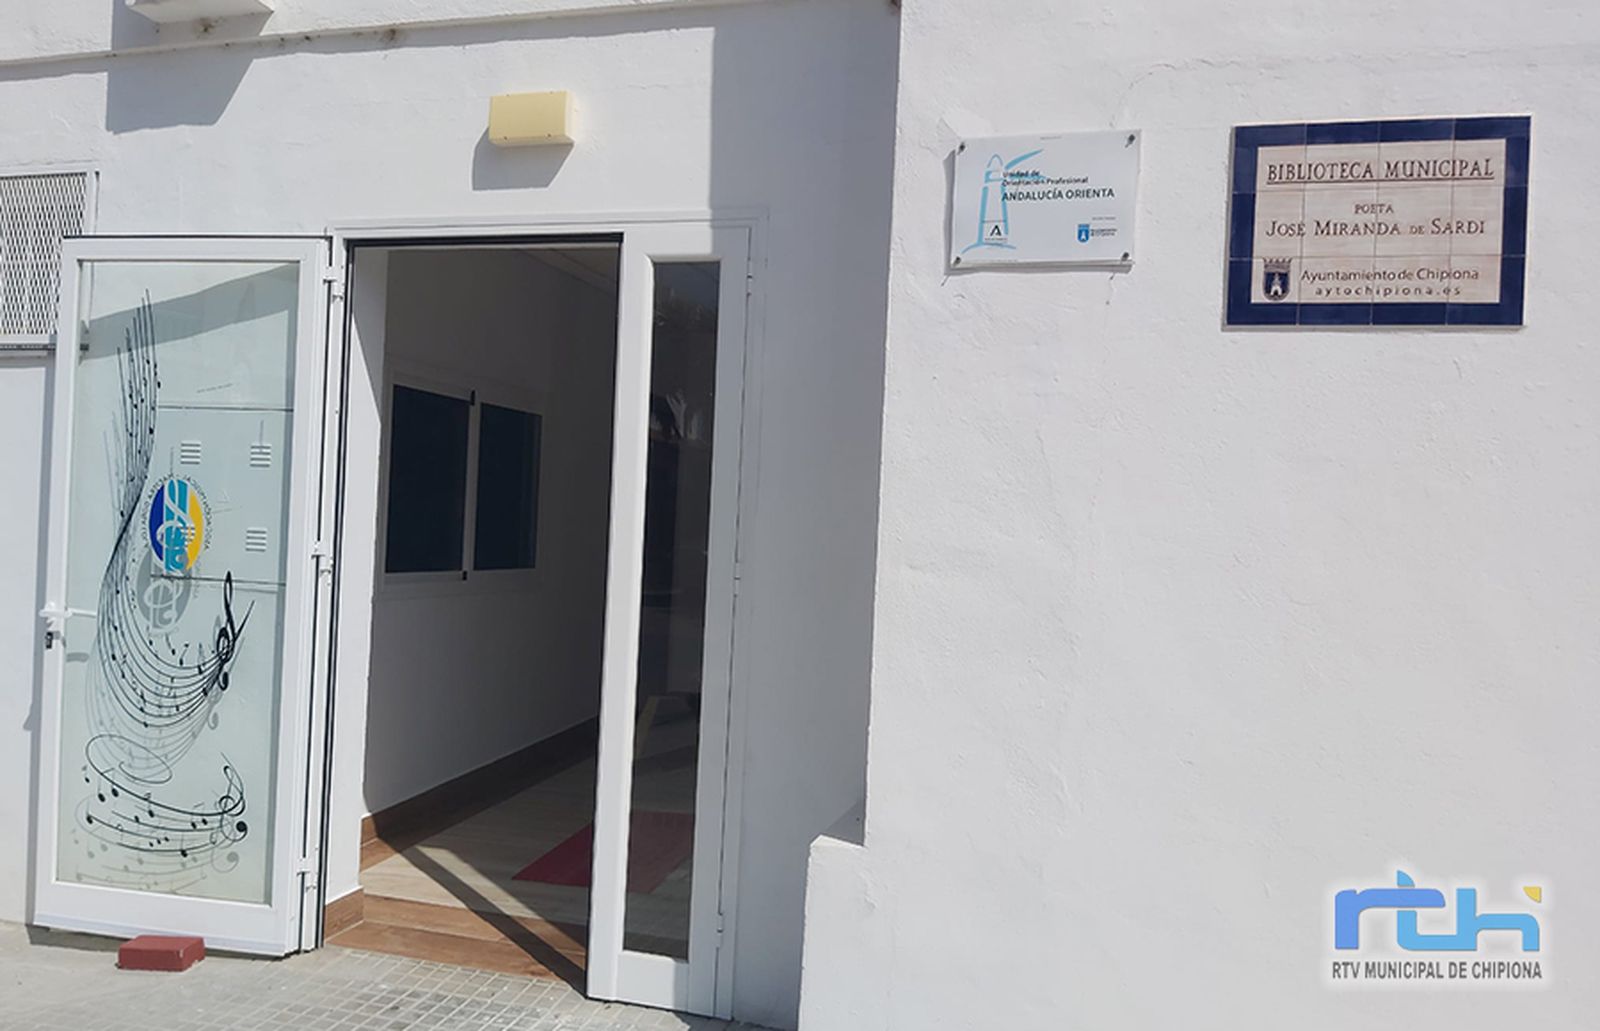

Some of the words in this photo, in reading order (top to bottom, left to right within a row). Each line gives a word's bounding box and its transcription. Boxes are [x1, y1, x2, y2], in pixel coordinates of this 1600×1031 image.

[1267, 161, 1374, 183] BIBLIOTECA
[1384, 158, 1495, 180] MUNICIPAL
[1048, 175, 1089, 185] Profesional
[1001, 190, 1063, 201] ANDALUCÍA
[1065, 187, 1115, 199] ORIENTA
[1354, 203, 1394, 215] POETA
[1314, 219, 1401, 237] MIRANDA
[1431, 218, 1485, 235] SARDI
[1301, 268, 1396, 282] Ayuntamiento
[1397, 268, 1413, 280] de
[1416, 266, 1479, 281] Chipiona
[1314, 284, 1462, 297] aytochipiona.es
